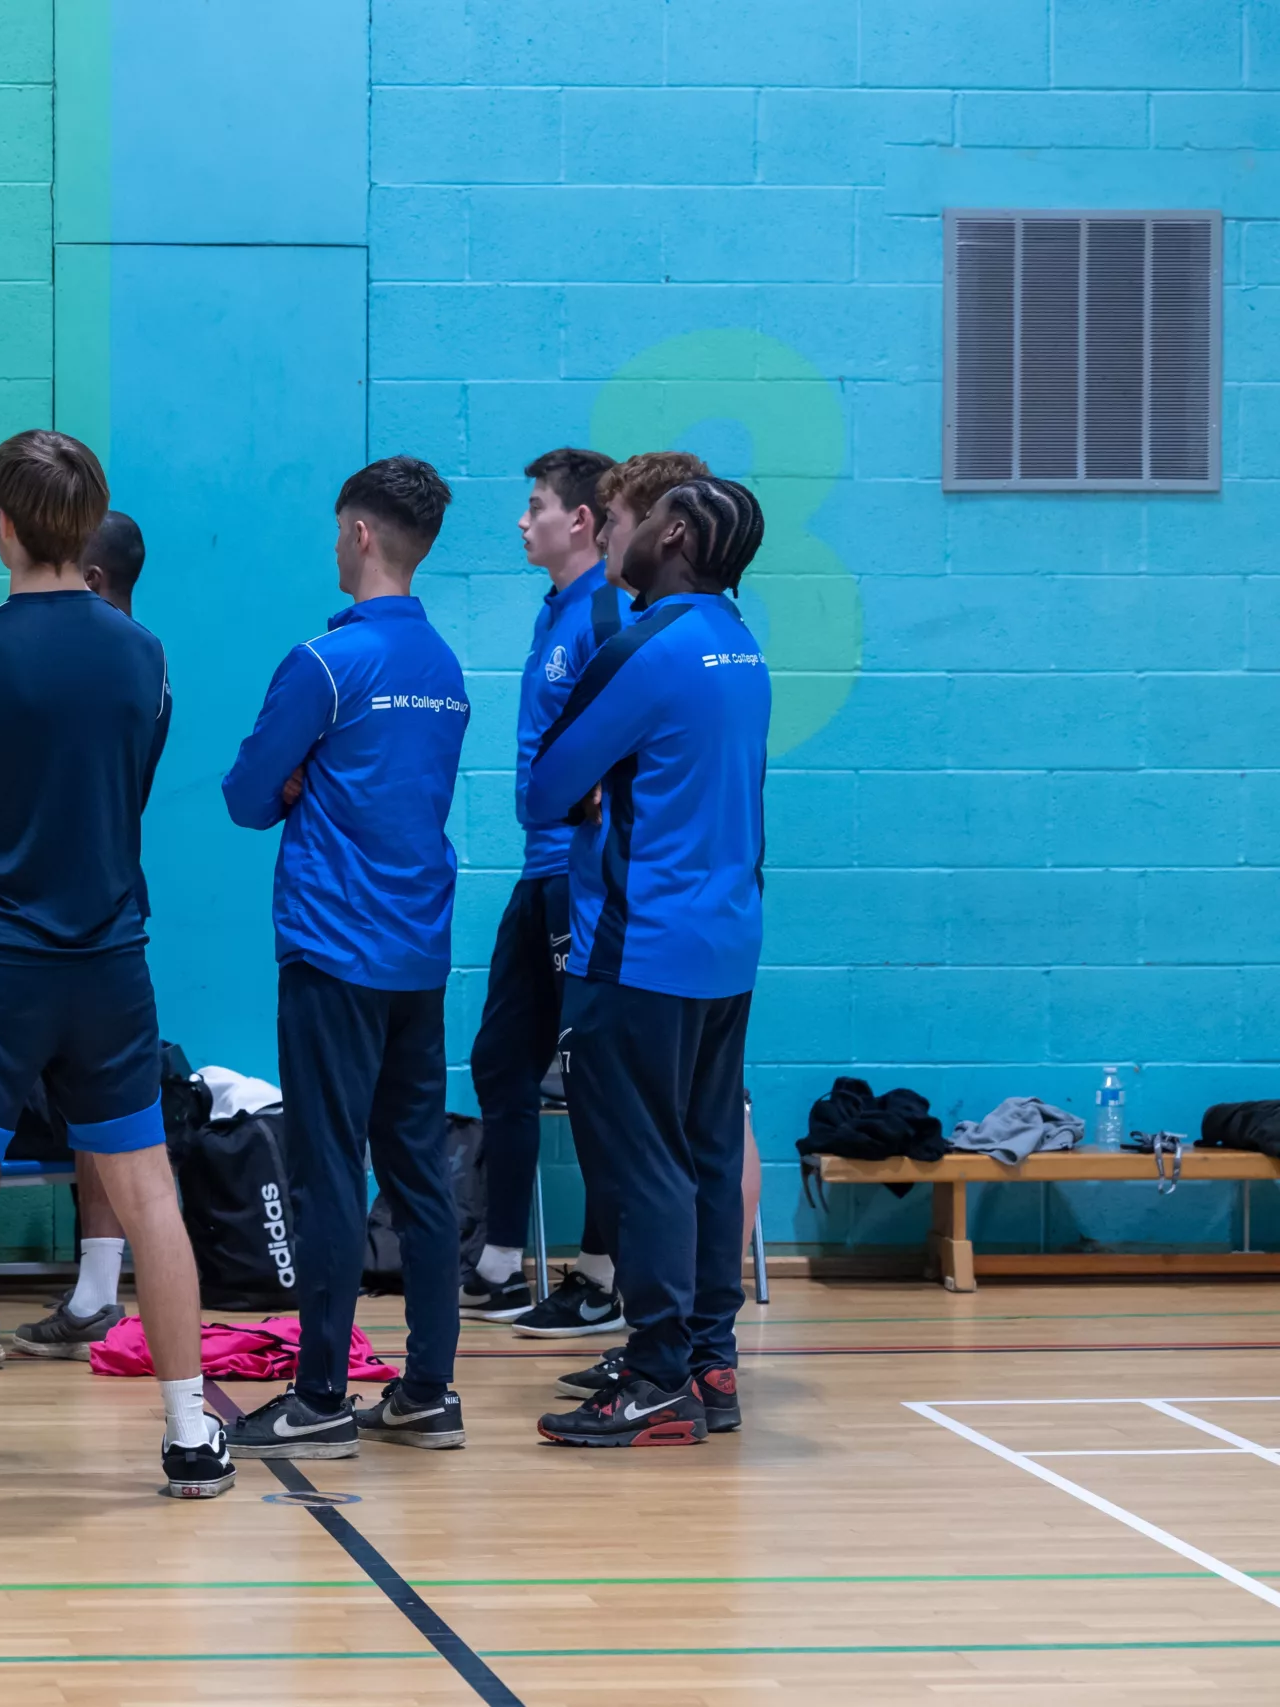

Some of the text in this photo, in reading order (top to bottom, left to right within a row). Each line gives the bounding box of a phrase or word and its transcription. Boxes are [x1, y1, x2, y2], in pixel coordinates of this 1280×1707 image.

[732, 653, 759, 667] College
[393, 695, 410, 708] MK
[411, 695, 445, 712] College
[261, 1182, 296, 1288] adidas
